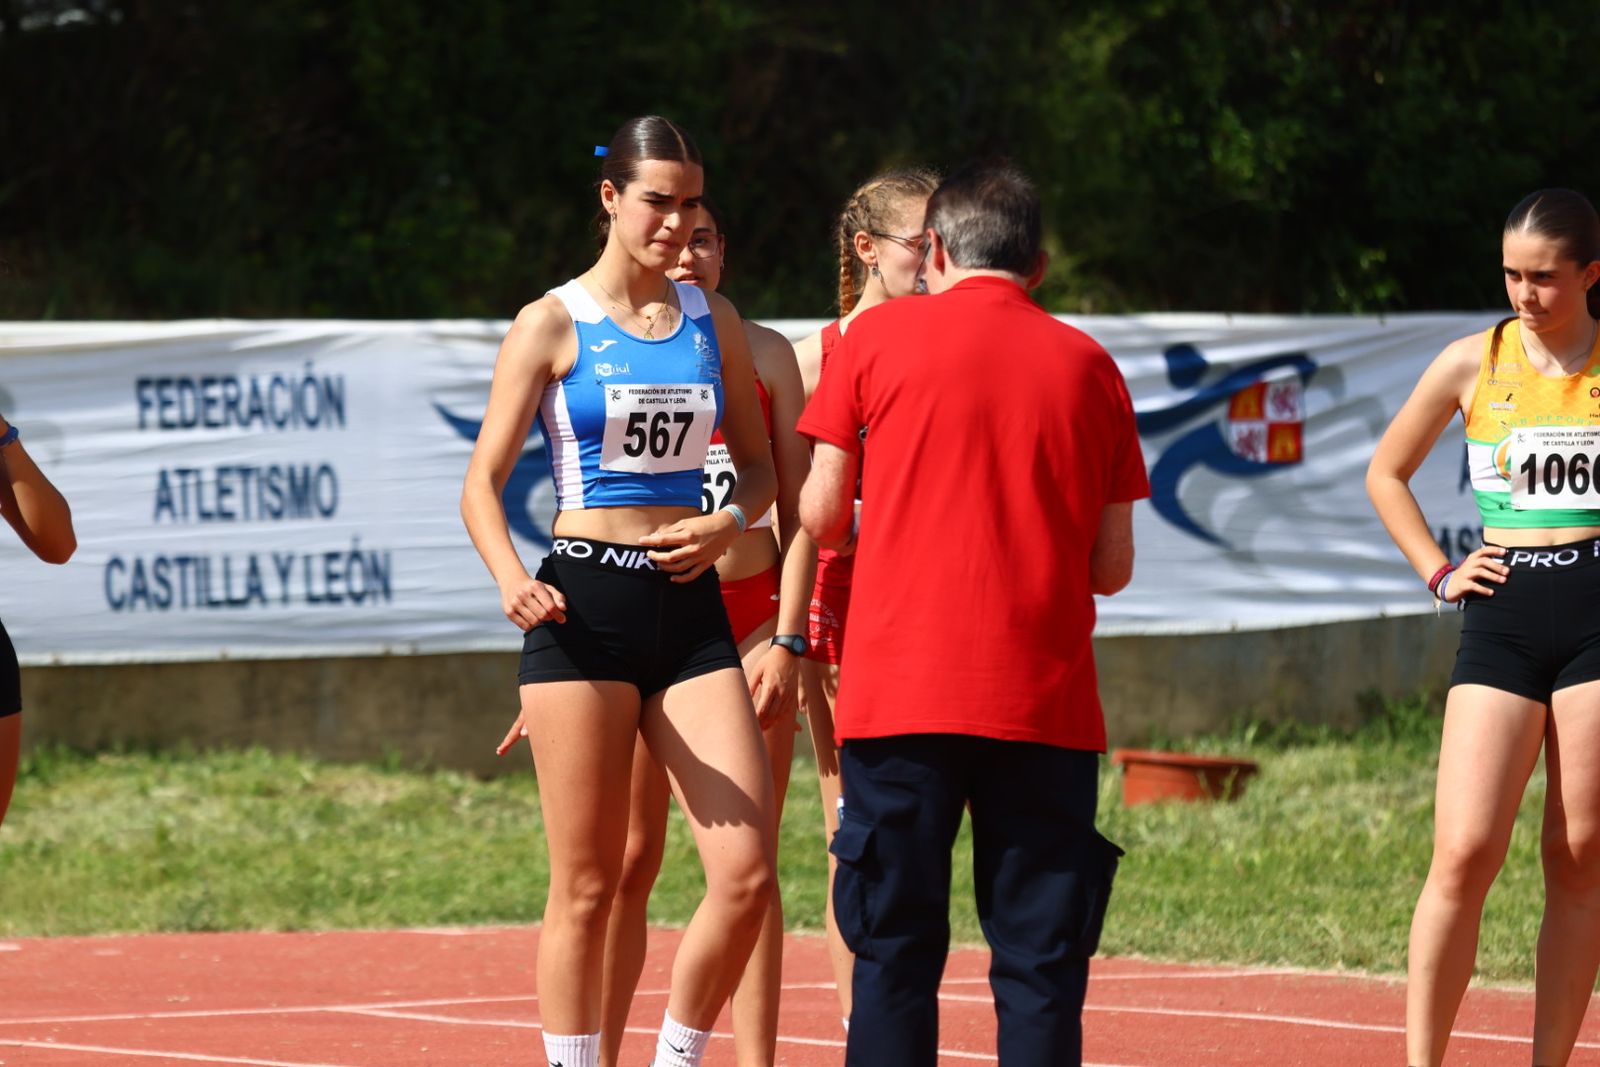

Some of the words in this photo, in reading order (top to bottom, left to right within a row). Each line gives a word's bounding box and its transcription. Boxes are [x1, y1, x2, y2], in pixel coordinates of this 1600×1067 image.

[135, 359, 346, 430] FEDERACIÓN
[623, 411, 694, 459] 567
[153, 463, 339, 522] ATLETISMO
[104, 553, 267, 612] CASTILLA
[273, 552, 295, 603] Y
[304, 536, 393, 605] LEÓN
[600, 547, 657, 571] NIK
[1510, 549, 1579, 568] PRO
